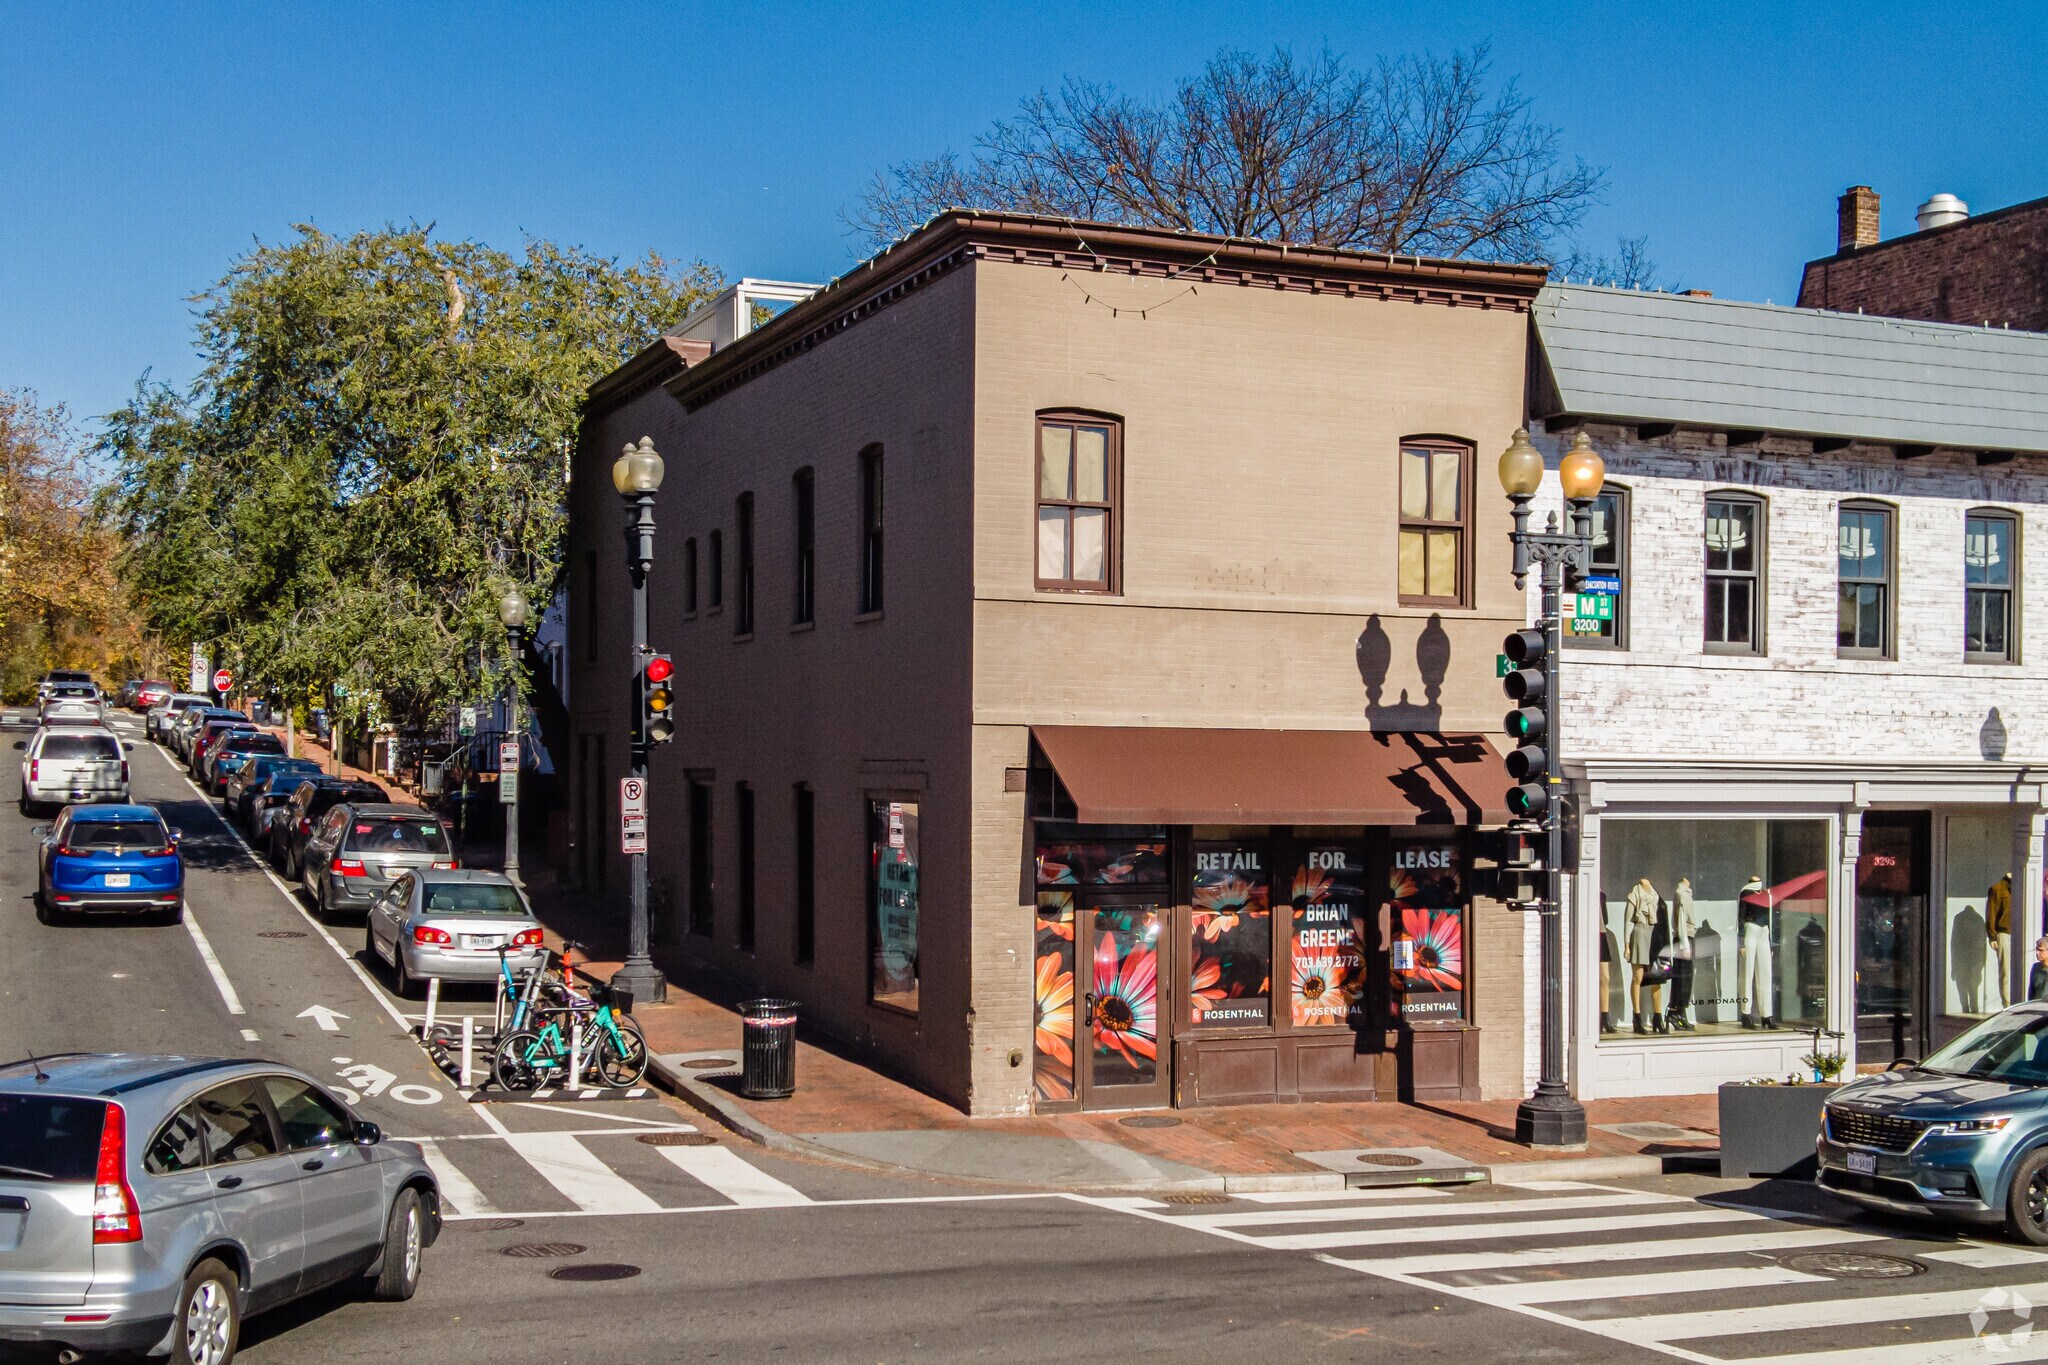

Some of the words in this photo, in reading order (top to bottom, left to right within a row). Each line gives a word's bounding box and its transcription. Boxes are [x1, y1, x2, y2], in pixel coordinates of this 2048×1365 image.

[1581, 597, 1595, 616] M
[1600, 598, 1608, 607] ST
[1600, 608, 1609, 617] NW
[1574, 619, 1599, 632] 3200
[1197, 852, 1261, 870] RETAIL
[1309, 851, 1346, 870] FOR
[1395, 850, 1451, 869] LEASE
[1306, 903, 1348, 922] BRIAN
[1300, 928, 1355, 948] GREENE
[1707, 997, 1749, 1005] MONACO
[1304, 1005, 1362, 1016] ROSENTHAL
[1401, 1002, 1458, 1013] ROSENTHAL
[1204, 1008, 1264, 1020] ROSENTHAL
